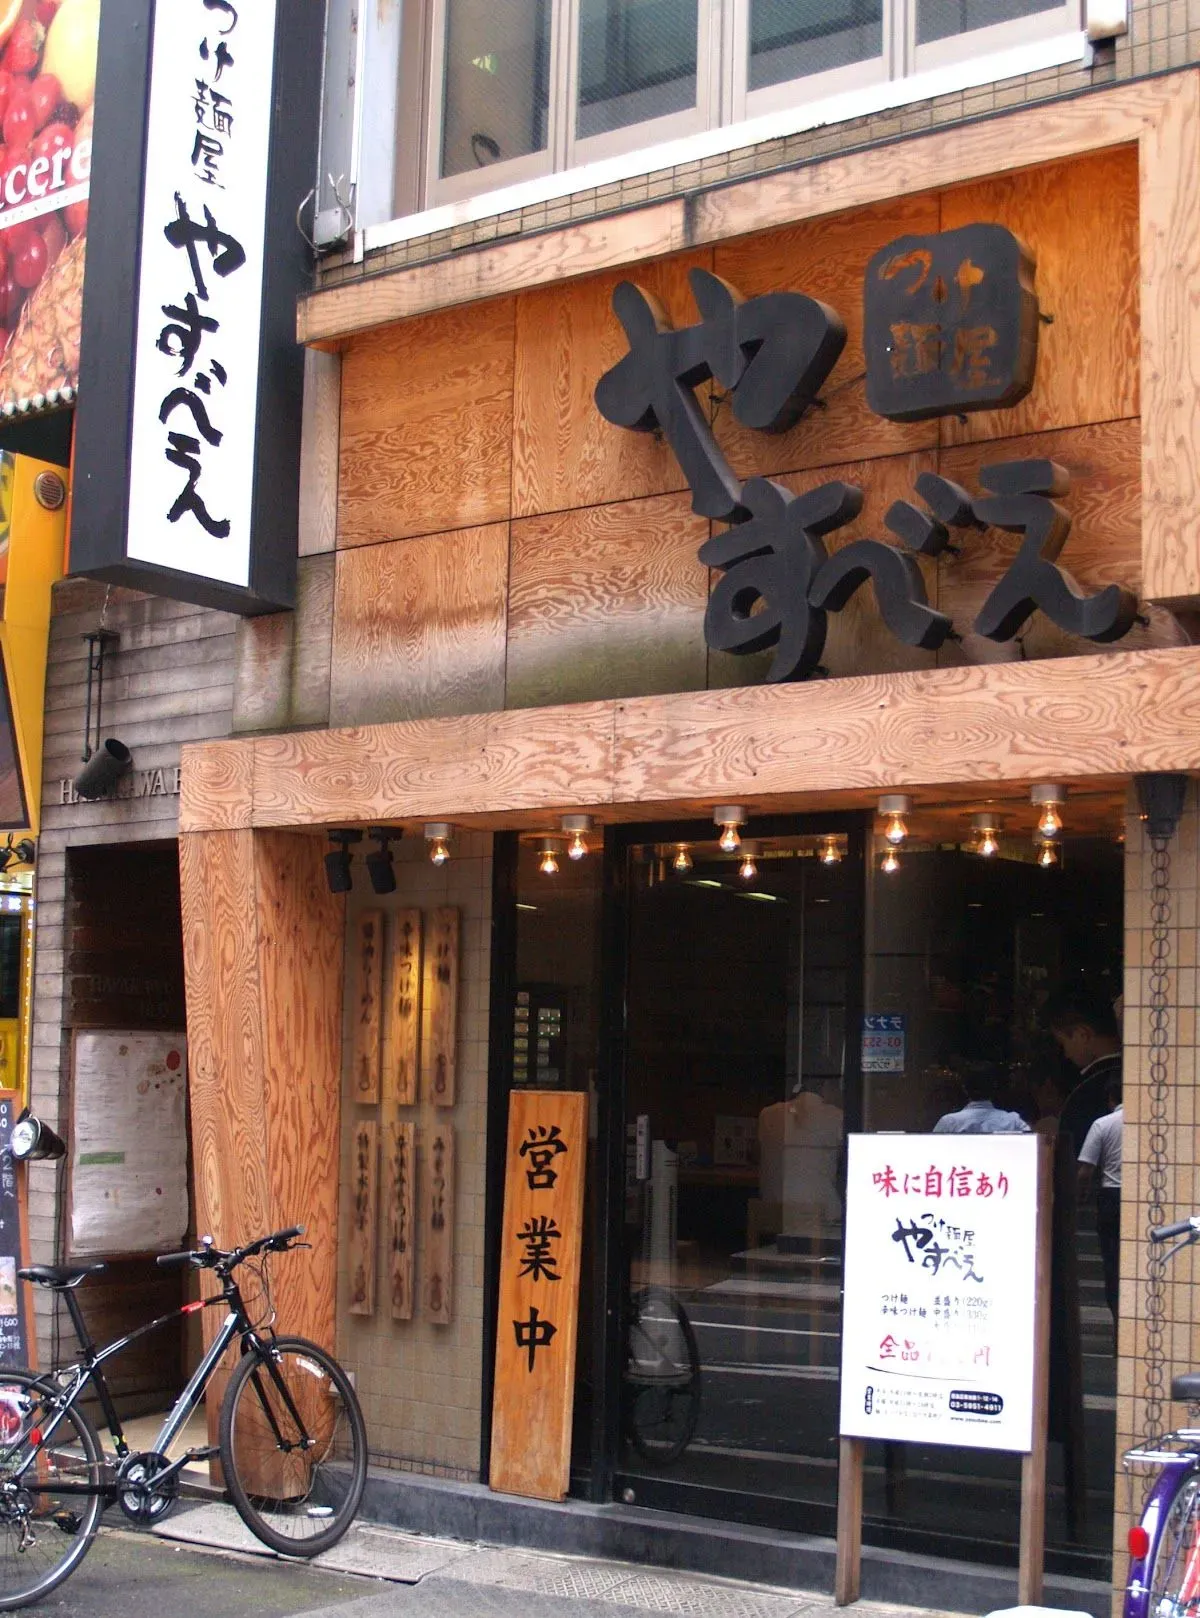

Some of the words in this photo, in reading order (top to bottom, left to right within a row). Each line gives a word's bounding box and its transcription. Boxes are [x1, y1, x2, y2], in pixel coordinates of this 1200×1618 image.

[190, 0, 236, 190] つけ麺屋
[154, 190, 247, 540] やすべえ
[593, 266, 1148, 685] やすべえ
[511, 1125, 569, 1374] 営業中
[872, 1165, 1009, 1199] 味に自信あり
[891, 1217, 984, 1283] やすべえ
